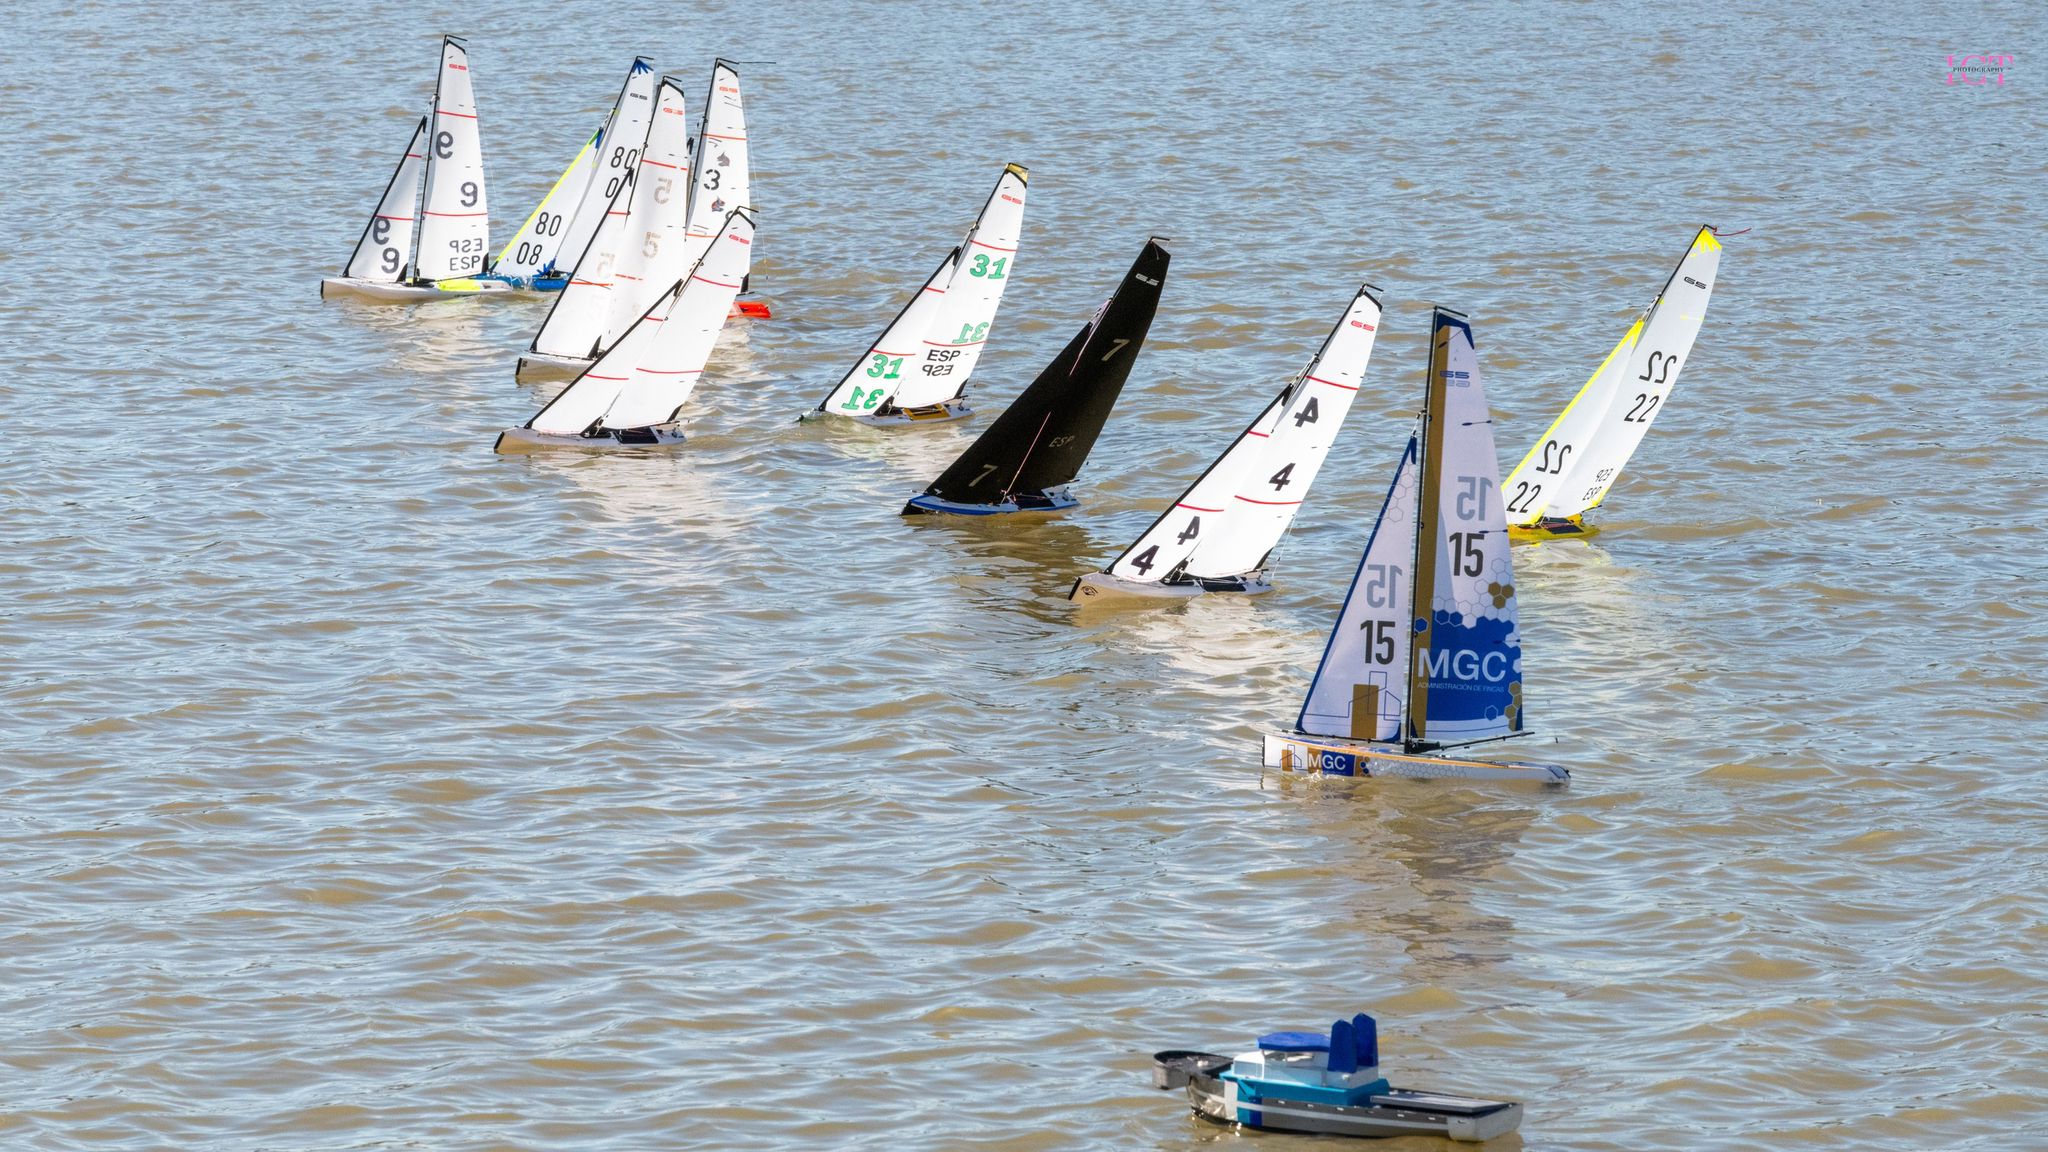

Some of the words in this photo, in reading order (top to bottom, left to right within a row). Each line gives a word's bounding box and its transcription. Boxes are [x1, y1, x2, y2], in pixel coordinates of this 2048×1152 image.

[703, 169, 721, 191] 3
[460, 181, 478, 207] 9
[641, 232, 662, 258] 5
[381, 247, 400, 274] 9
[449, 255, 481, 271] ESP
[969, 254, 1007, 280] 31
[926, 349, 961, 362] ESP
[1101, 338, 1131, 362] 7
[866, 354, 904, 379] 31
[1624, 393, 1661, 423] 22
[968, 463, 999, 488] 7
[1268, 462, 1296, 492] 4
[1506, 481, 1542, 514] 22
[1130, 544, 1161, 576] 4
[1449, 531, 1486, 578] 15
[1359, 619, 1397, 665] 15
[1417, 648, 1507, 682] MGC
[1417, 681, 1473, 692] ADMINISTRACIÓN
[1308, 753, 1346, 770] MGC
